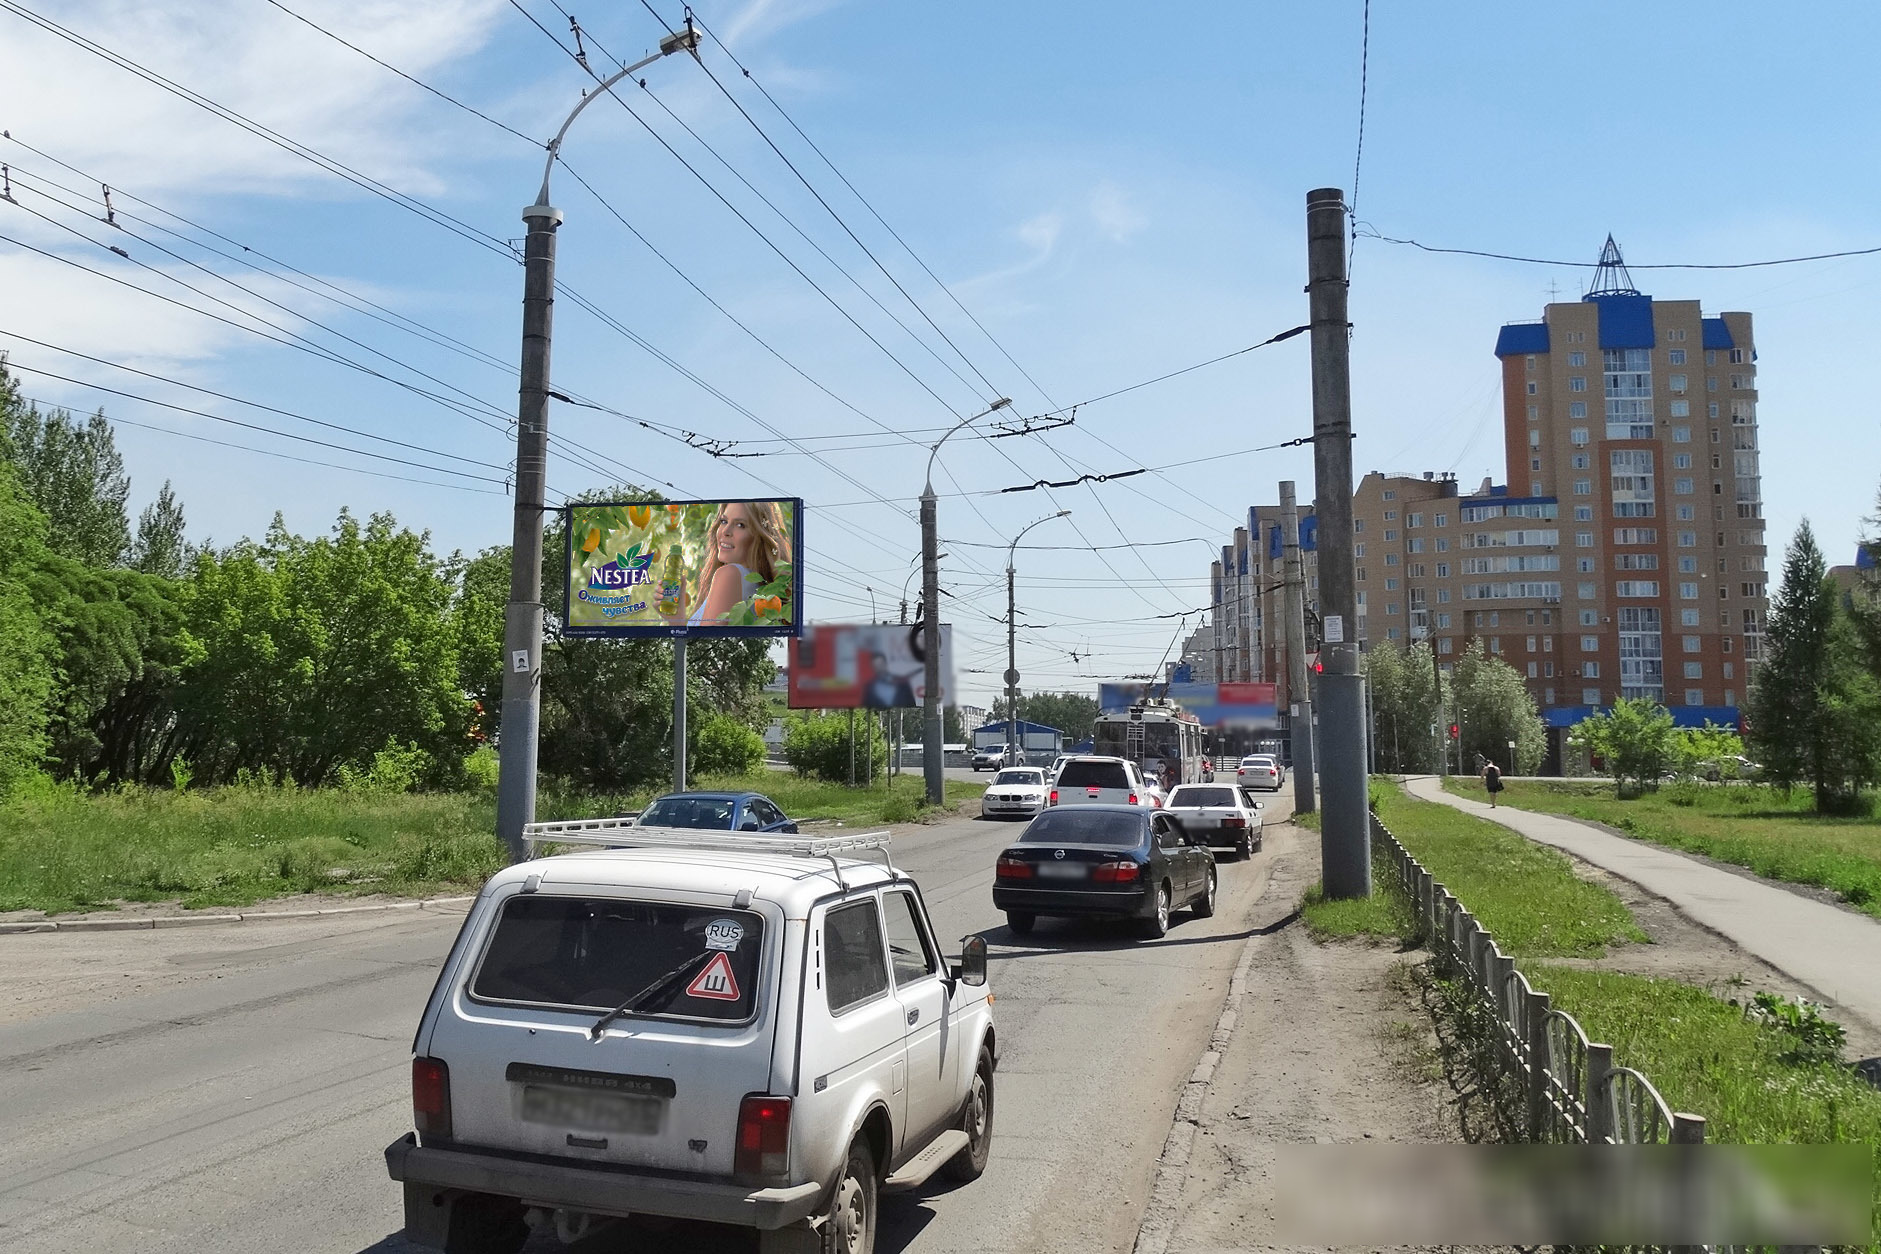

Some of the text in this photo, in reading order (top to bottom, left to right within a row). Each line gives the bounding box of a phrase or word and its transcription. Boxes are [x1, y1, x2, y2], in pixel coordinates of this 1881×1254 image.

[591, 567, 651, 585] NESTEA
[578, 589, 631, 604] Оживляет
[602, 601, 647, 618] чувства
[709, 924, 740, 939] RUS
[704, 974, 726, 992] Ш
